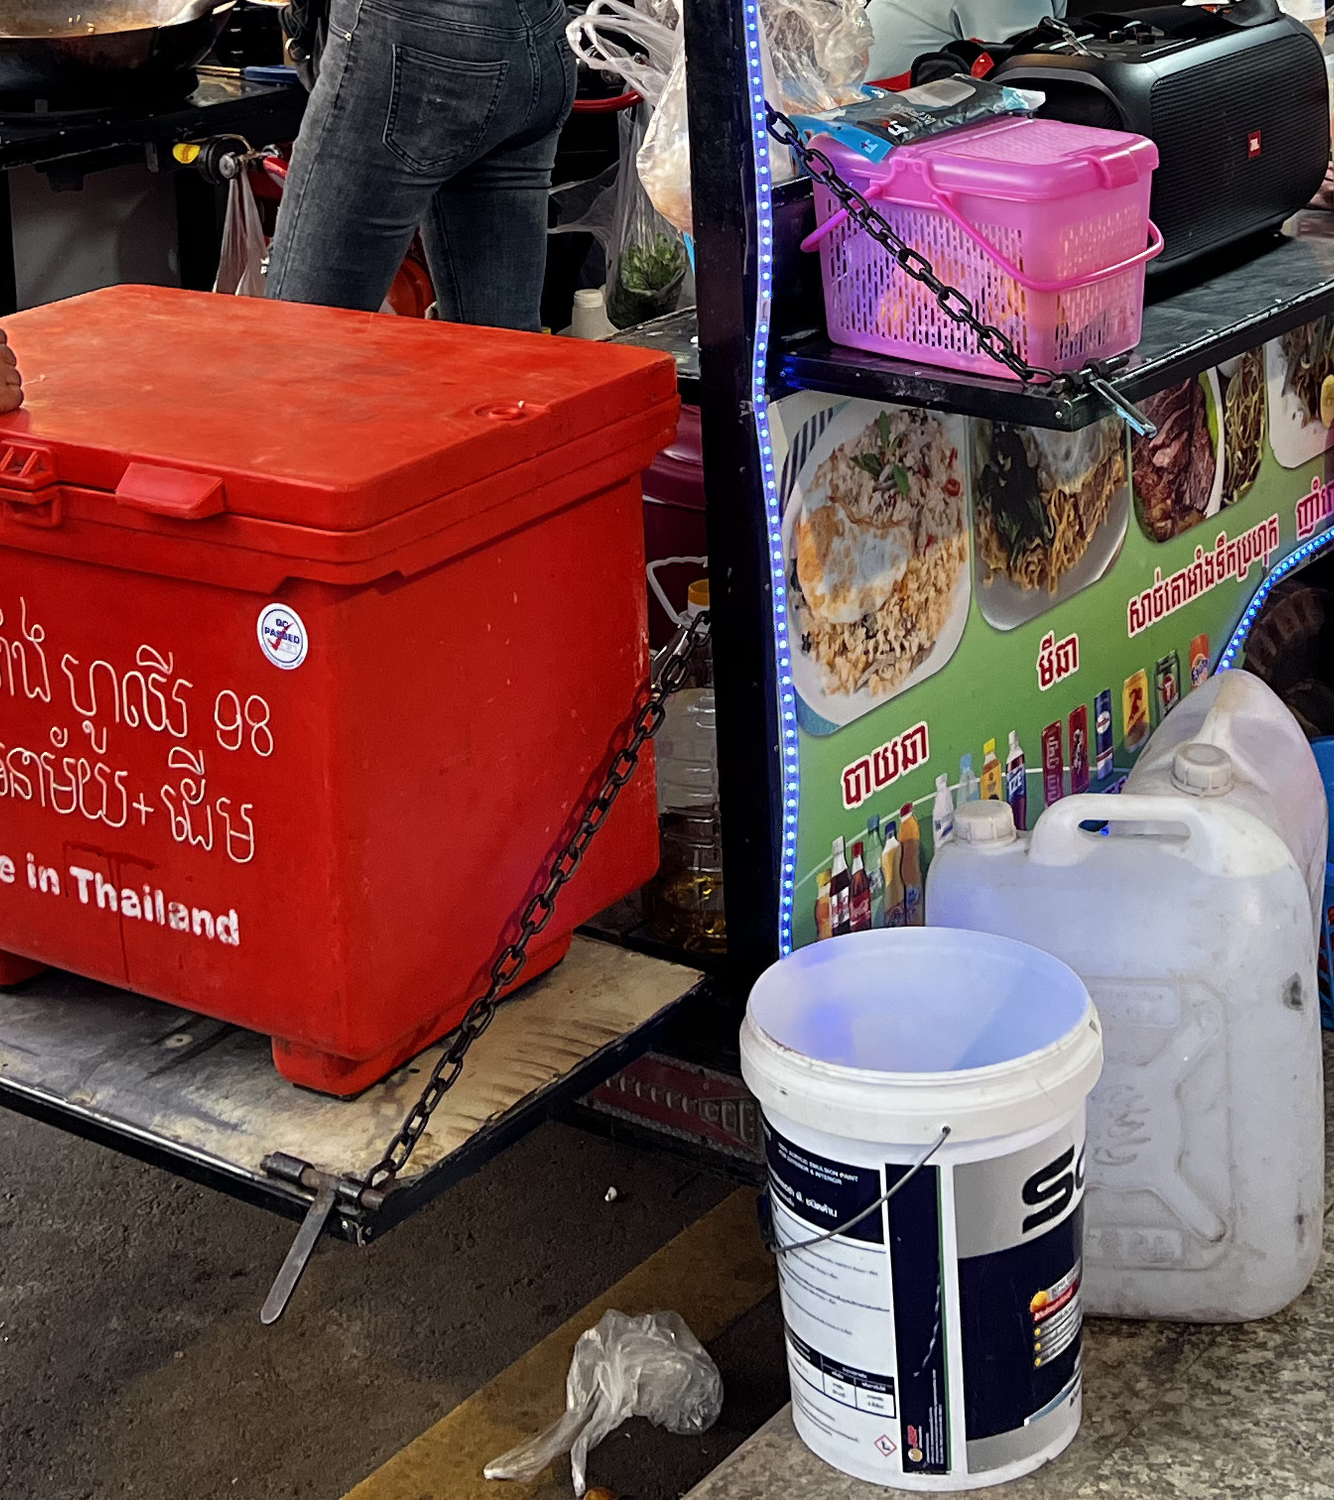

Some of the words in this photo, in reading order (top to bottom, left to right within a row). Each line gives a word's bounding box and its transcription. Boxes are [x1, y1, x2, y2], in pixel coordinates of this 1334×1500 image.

[1037, 631, 1079, 690] មីឆា
[214, 689, 274, 757] 98
[841, 722, 929, 808] បាយឆា
[26, 852, 61, 896] in
[69, 864, 241, 947] Thailand
[839, 1172, 859, 1183] PAINT
